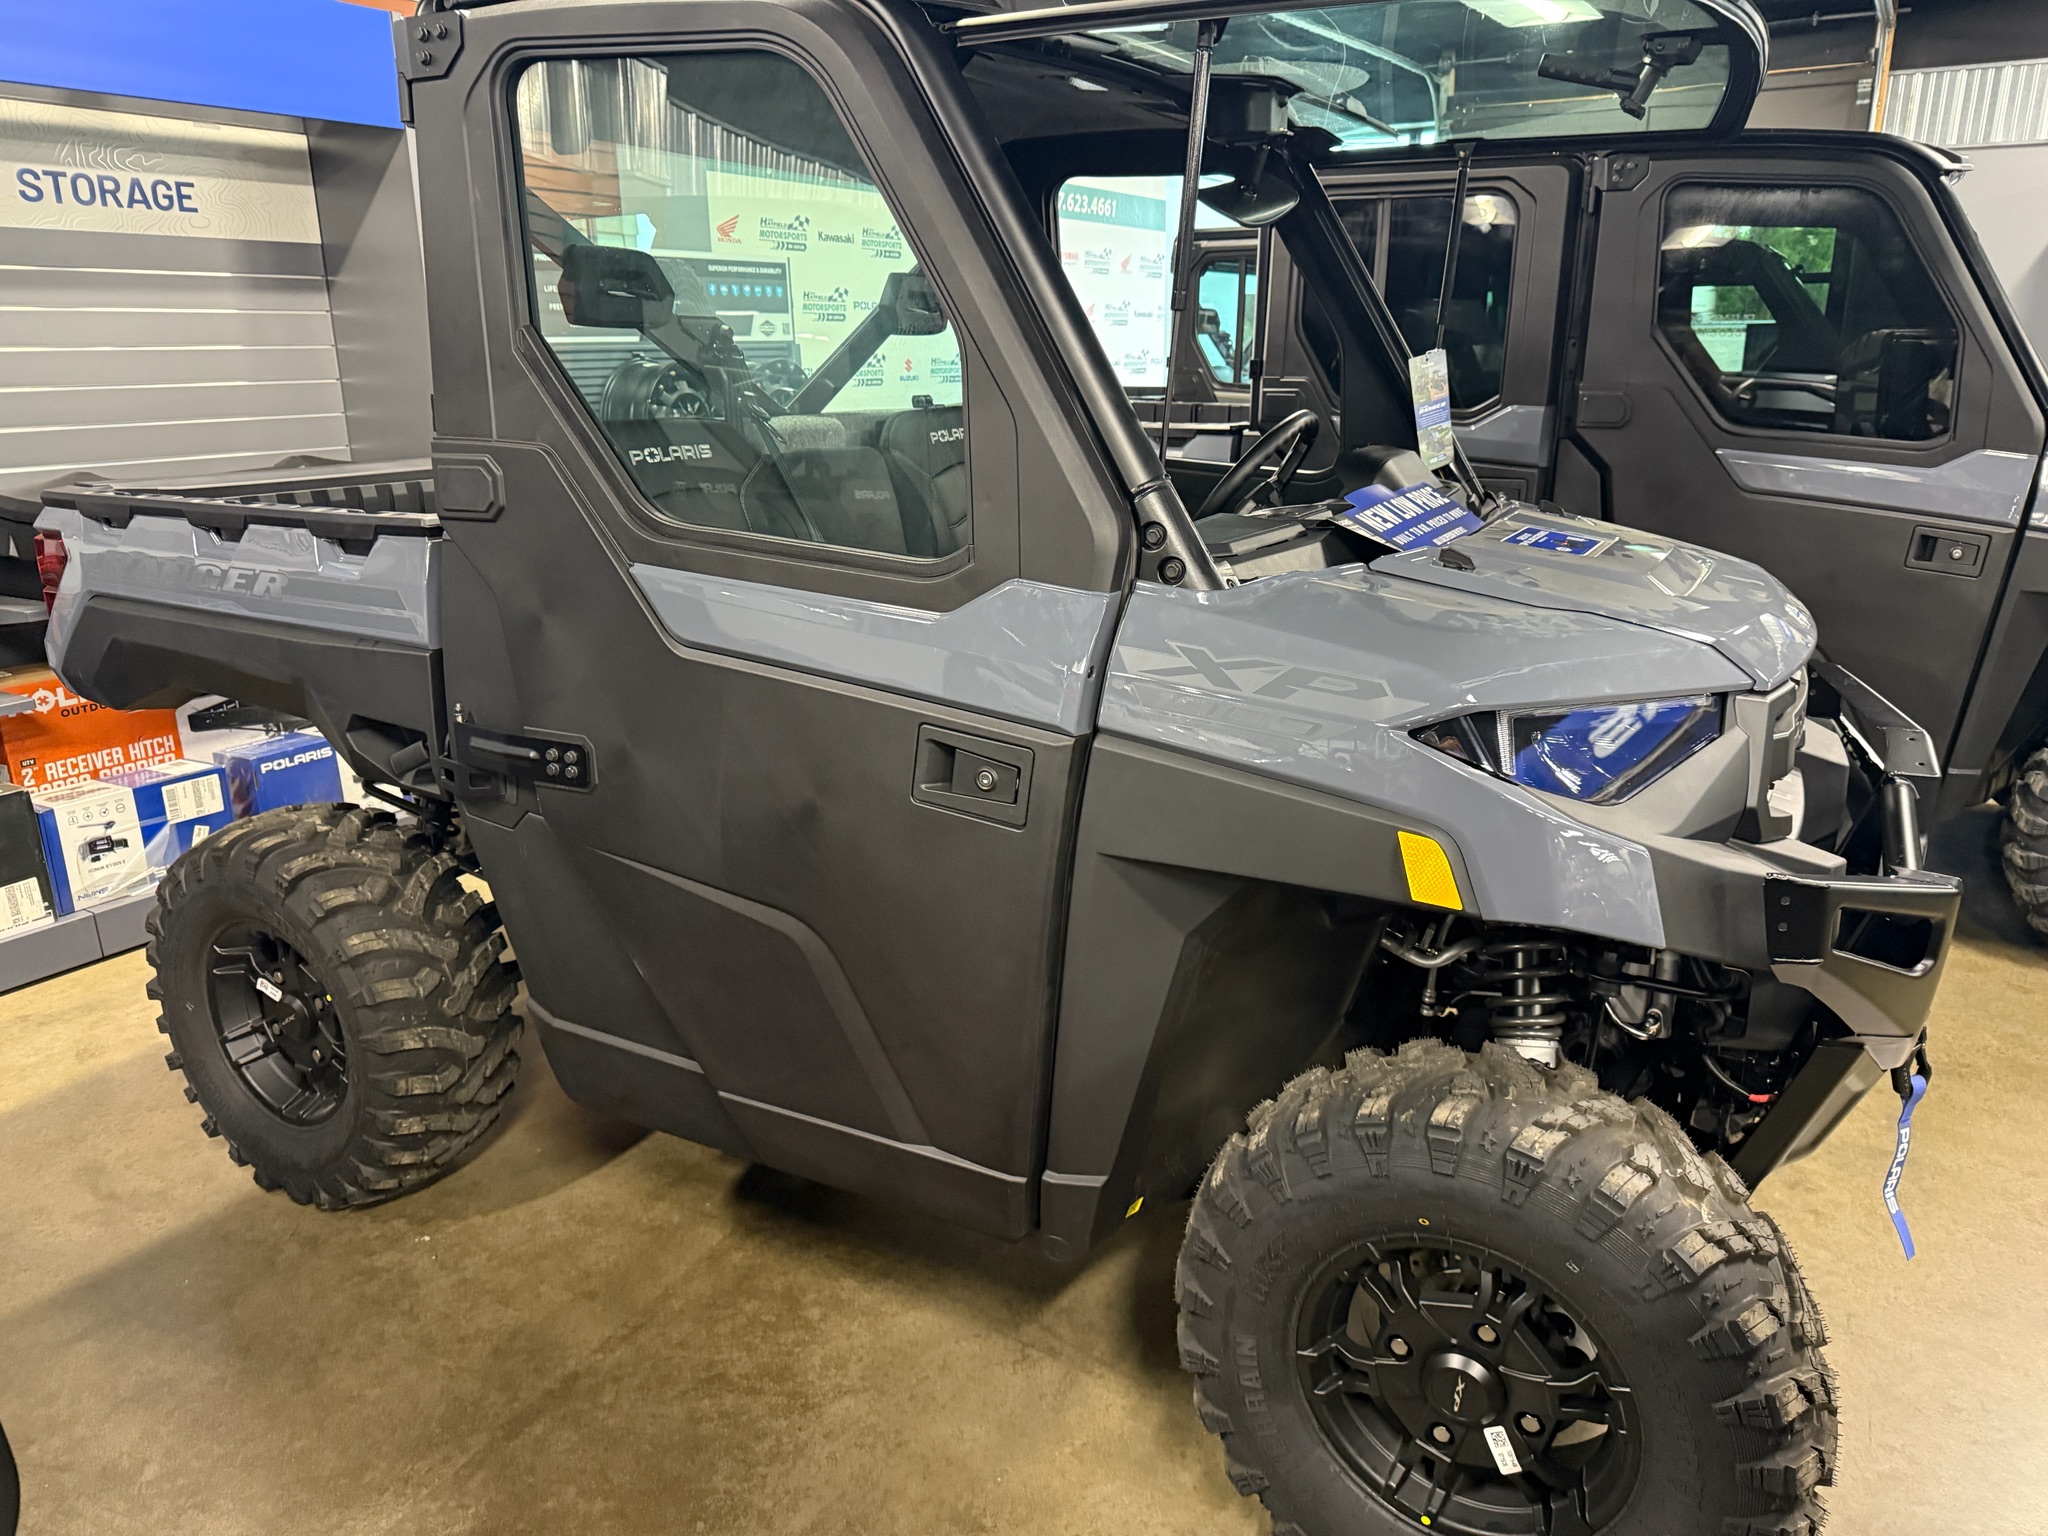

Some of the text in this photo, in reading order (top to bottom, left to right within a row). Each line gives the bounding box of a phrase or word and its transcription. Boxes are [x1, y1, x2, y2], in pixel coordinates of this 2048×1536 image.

[16, 167, 199, 214] STORAGE
[759, 229, 808, 242] MOTORSPORTS
[817, 231, 855, 244] Kawasaki
[861, 238, 902, 249] MOTORSPORTS
[802, 302, 847, 312] MOTORSPORTS
[628, 443, 713, 466] POLARIS
[1383, 494, 1425, 520] LOW
[1403, 485, 1451, 511] PRICE
[1354, 502, 1404, 533] NEW
[1136, 643, 1390, 700] XP
[21, 759, 35, 767] UTV
[44, 746, 125, 782] RECEIVER
[127, 734, 176, 762] HITCH
[259, 746, 333, 775] POLARIS
[1883, 1126, 1910, 1215] POLARIS
